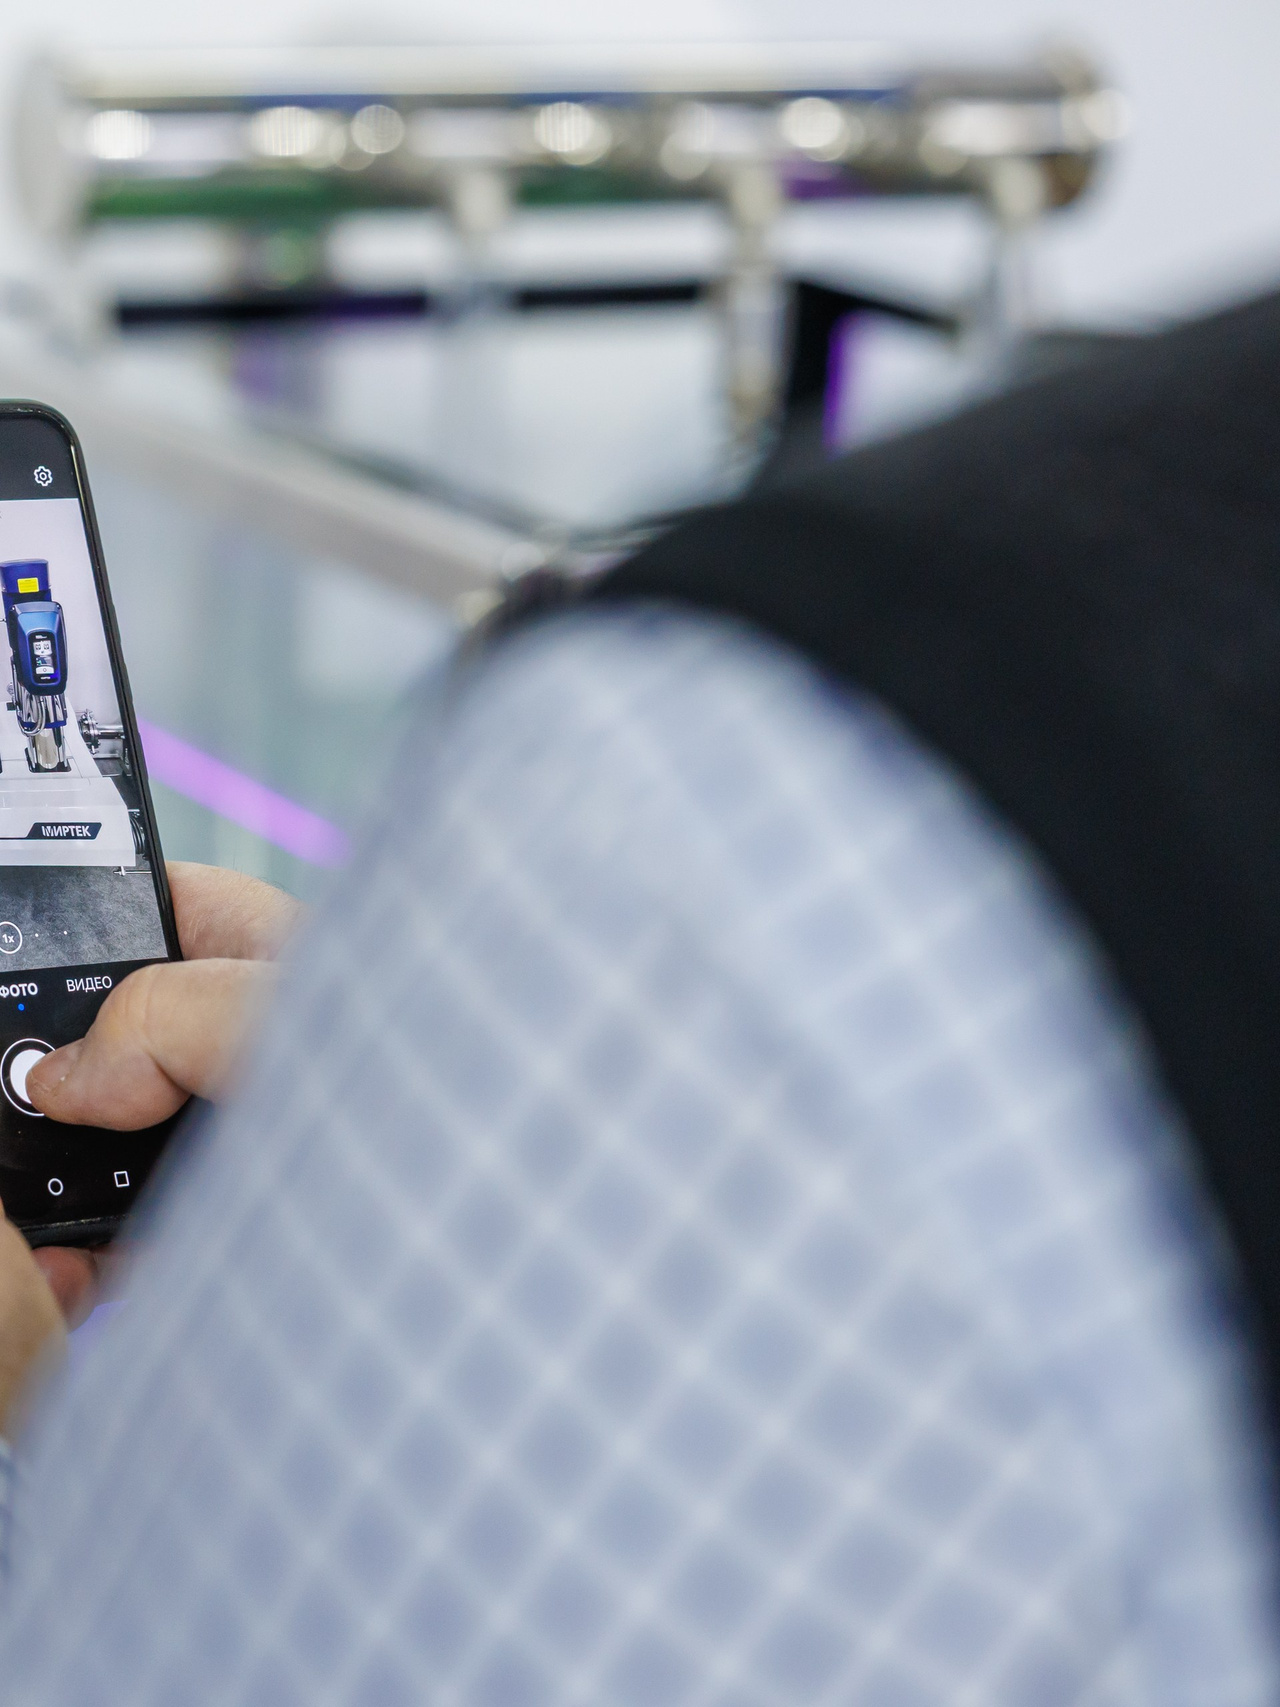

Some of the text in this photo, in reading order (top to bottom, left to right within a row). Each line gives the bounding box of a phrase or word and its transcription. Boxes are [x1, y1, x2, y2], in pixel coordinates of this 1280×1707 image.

[41, 824, 92, 838] МИРТЕК
[2, 932, 15, 944] 1x
[65, 975, 113, 993] ВИДЕО
